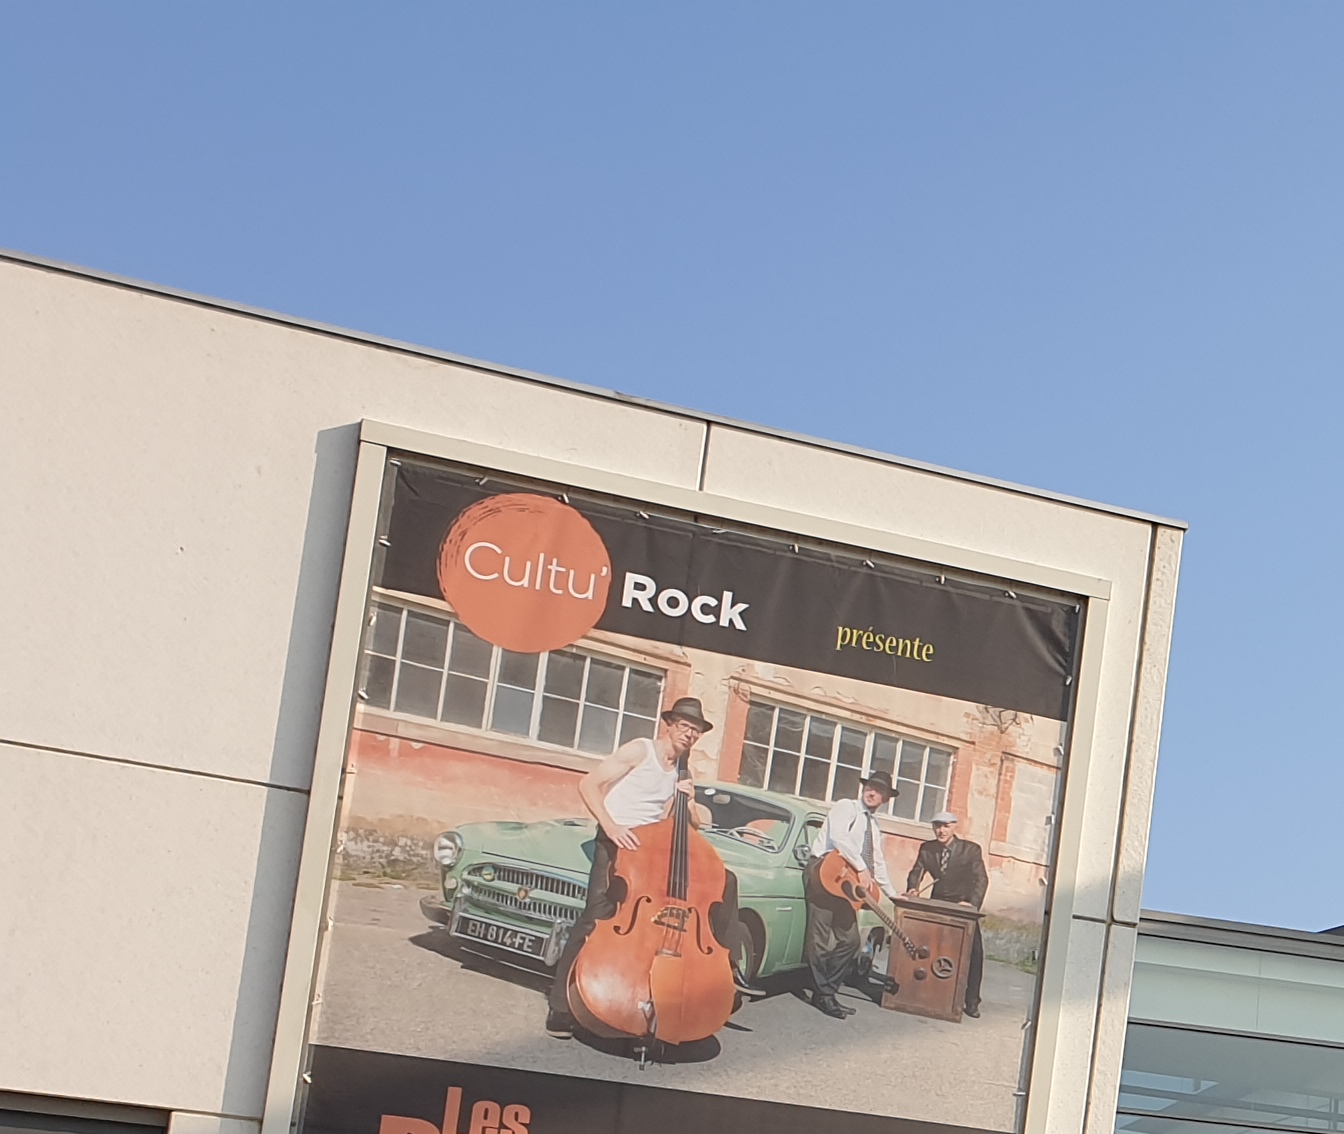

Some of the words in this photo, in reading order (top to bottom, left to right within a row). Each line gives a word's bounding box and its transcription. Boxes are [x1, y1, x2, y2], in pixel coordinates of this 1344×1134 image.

[464, 541, 607, 600] Cultu'
[621, 571, 750, 632] Rock
[835, 624, 936, 663] présente
